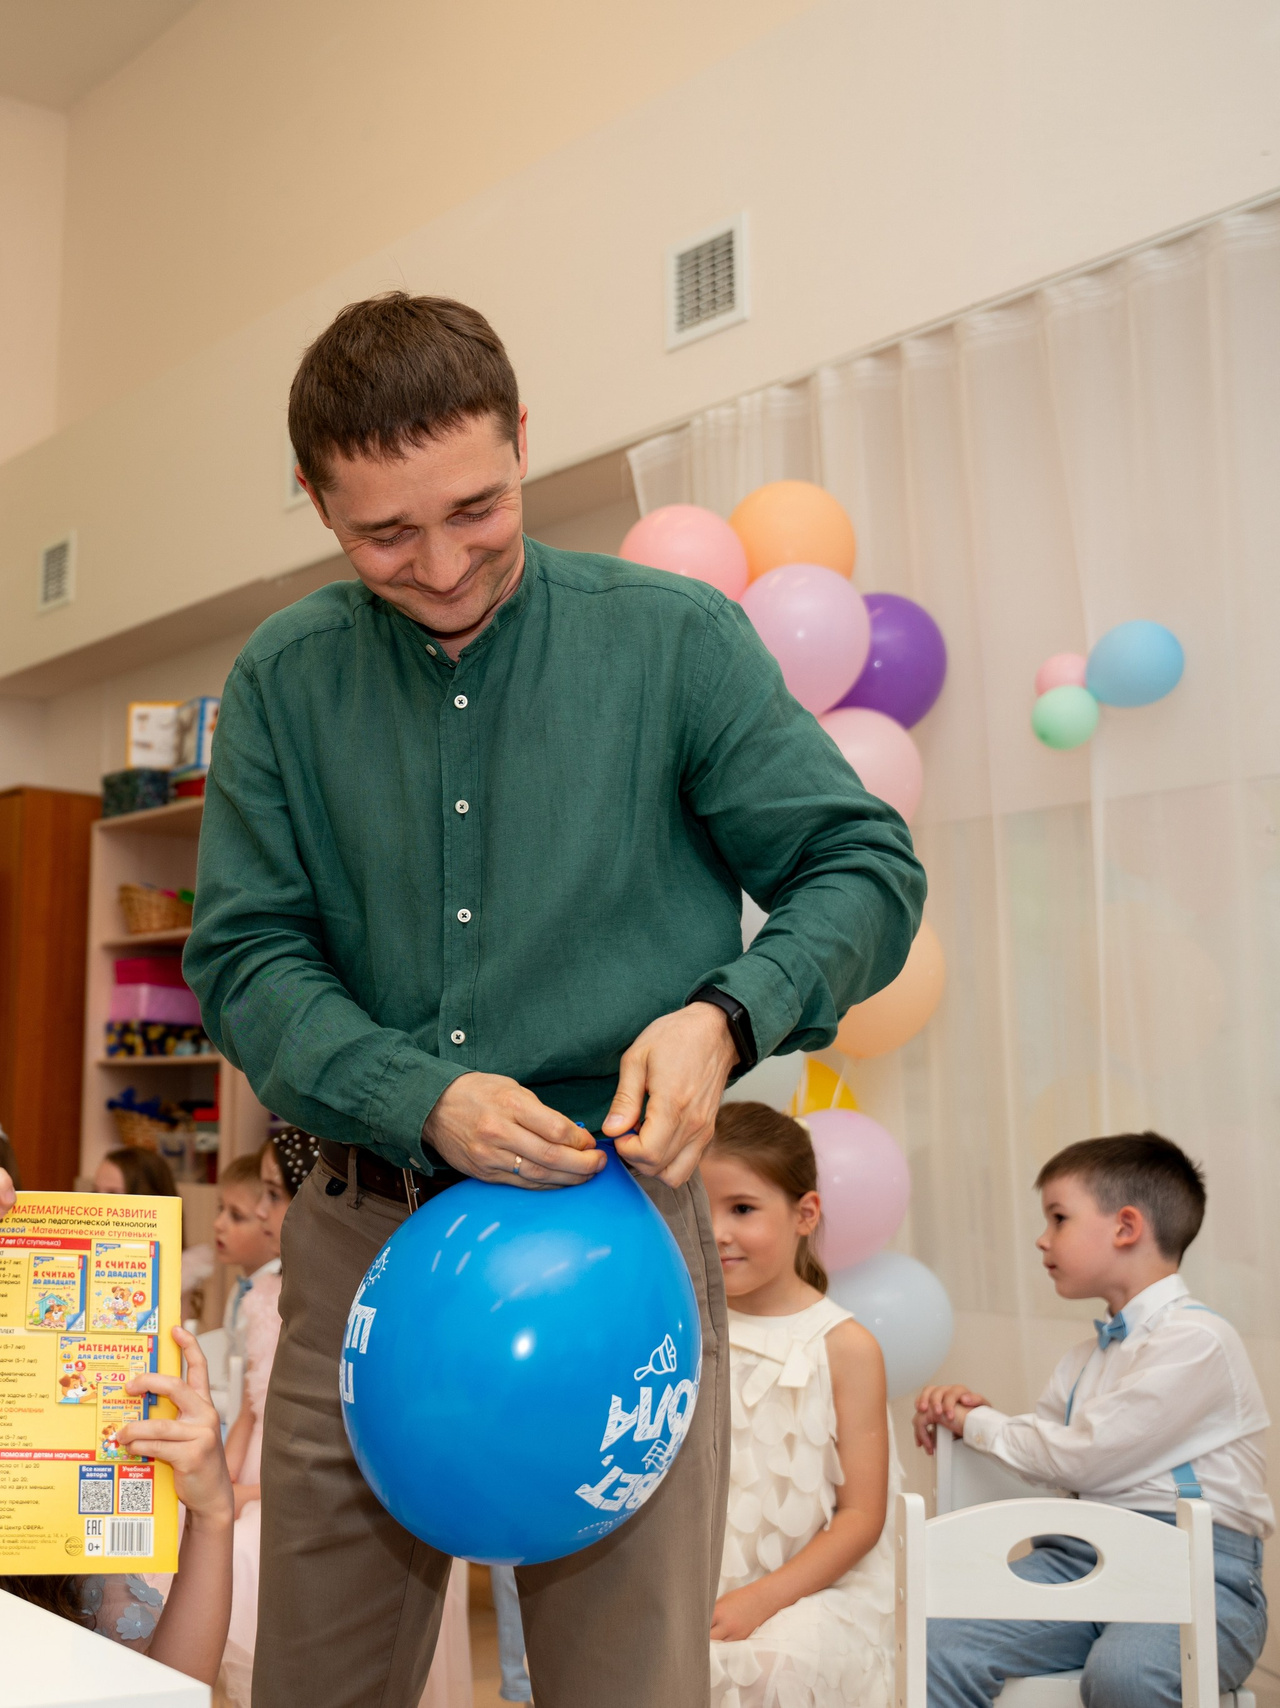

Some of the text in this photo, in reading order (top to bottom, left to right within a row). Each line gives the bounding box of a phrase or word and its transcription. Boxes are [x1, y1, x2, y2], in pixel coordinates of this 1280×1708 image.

[12, 1205, 103, 1217] МАТЕМАТИЧЕСКОЕ
[106, 1208, 157, 1219] РАЗВИТИЕ
[11, 1217, 46, 1225] помощью
[48, 1218, 111, 1227] педагогической
[95, 1260, 147, 1269] Я СЧИТАЮ
[133, 1293, 144, 1302] 20
[78, 1343, 144, 1353] МАТЕМАТИКА
[95, 1372, 102, 1382] 5
[110, 1373, 126, 1382] 20
[88, 1542, 100, 1552] 0+
